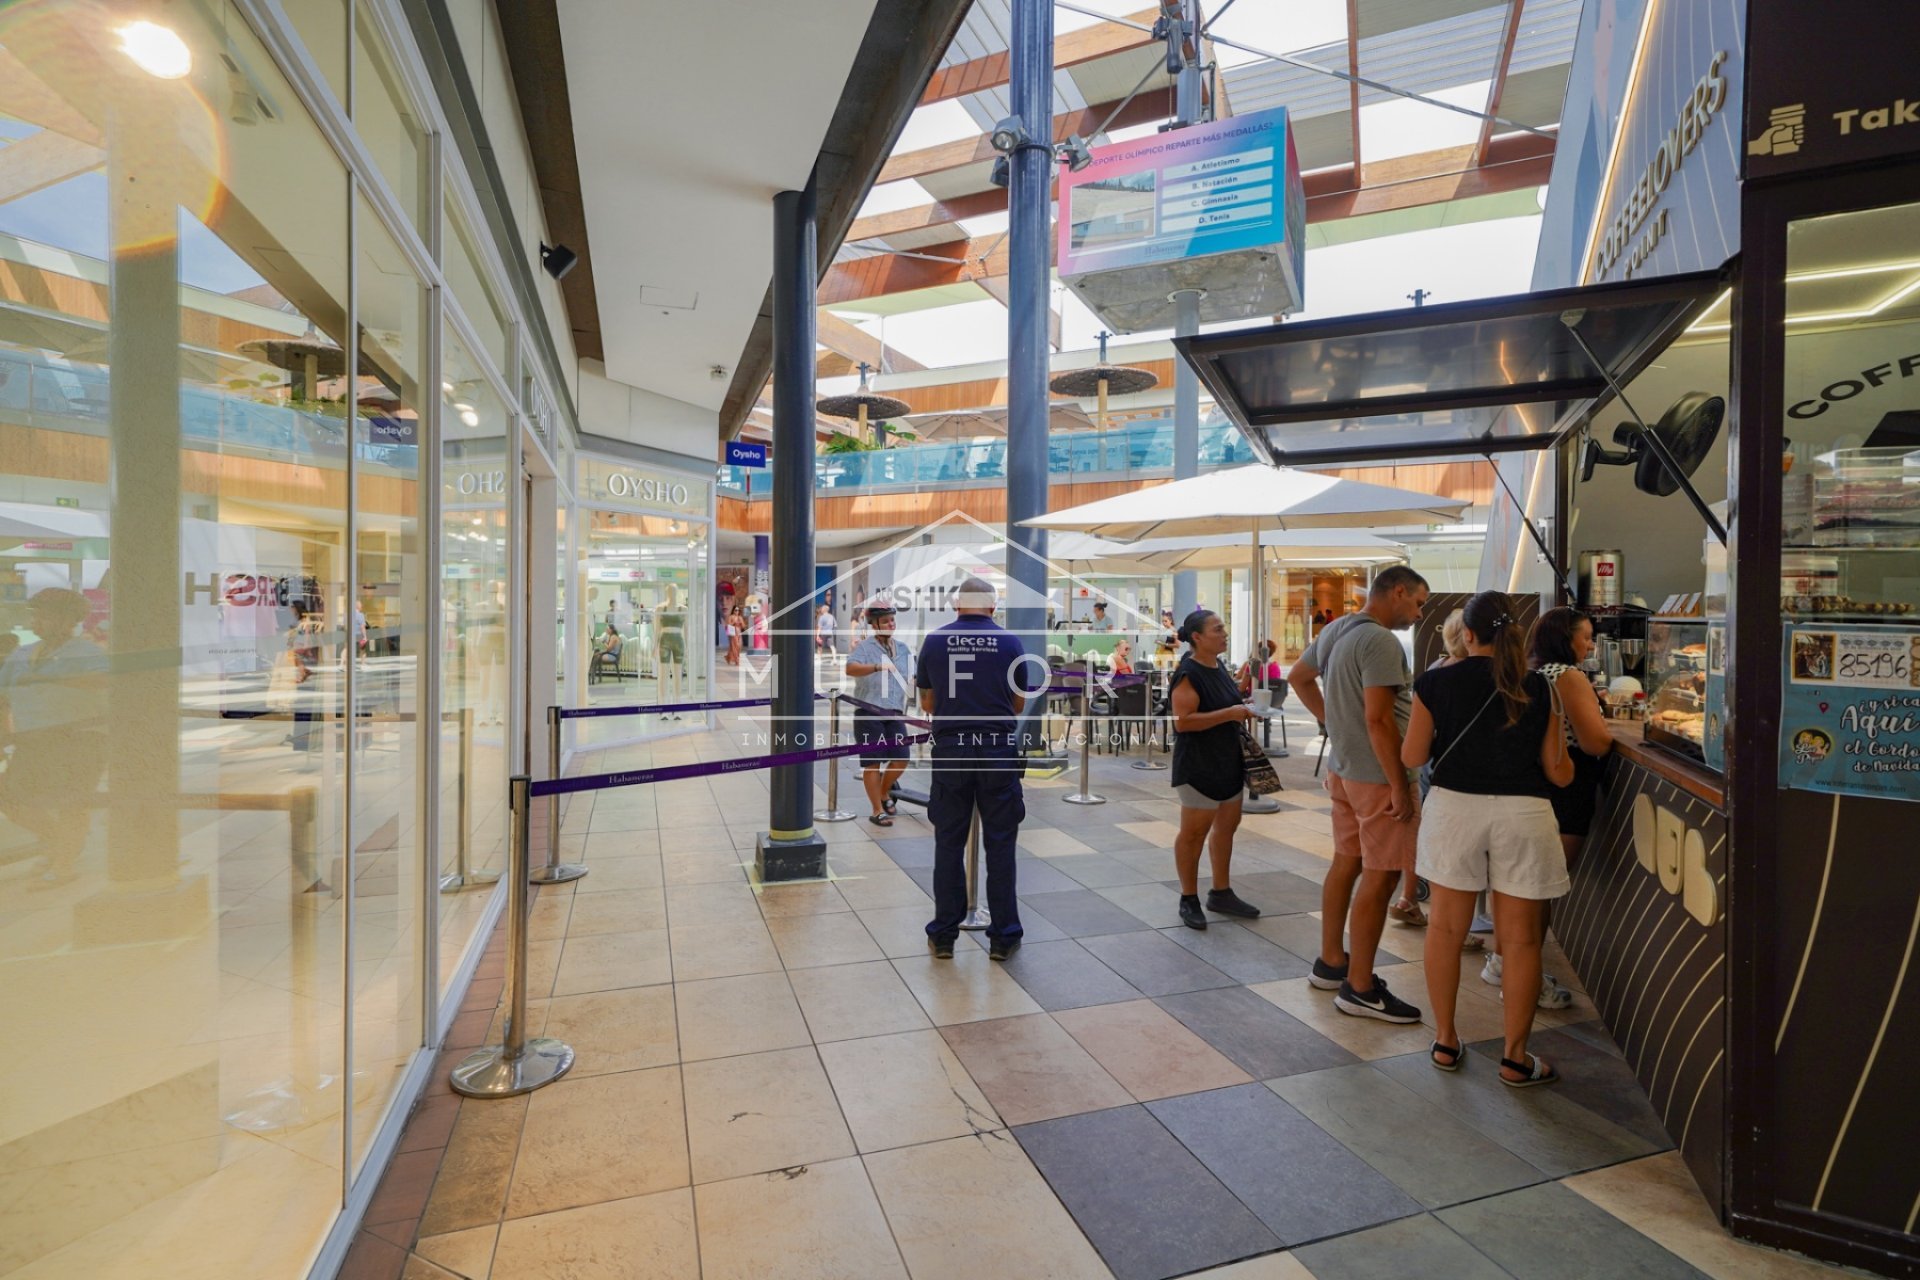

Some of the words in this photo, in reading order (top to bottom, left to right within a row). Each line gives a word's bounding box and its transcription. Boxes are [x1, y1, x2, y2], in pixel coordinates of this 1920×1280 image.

[1166, 138, 1201, 152] REPARTE
[1203, 131, 1222, 144] MÁS
[1201, 157, 1240, 170] Atletismo
[1624, 207, 1668, 280] POINT
[732, 449, 761, 461] Oysho
[607, 472, 688, 506] OYSHO
[946, 635, 986, 646] Clece
[1839, 652, 1909, 679] 85196
[1840, 704, 1920, 738] Aquí
[1844, 739, 1862, 755] el
[1854, 761, 1872, 773] de
[608, 772, 655, 784] Habaneras
